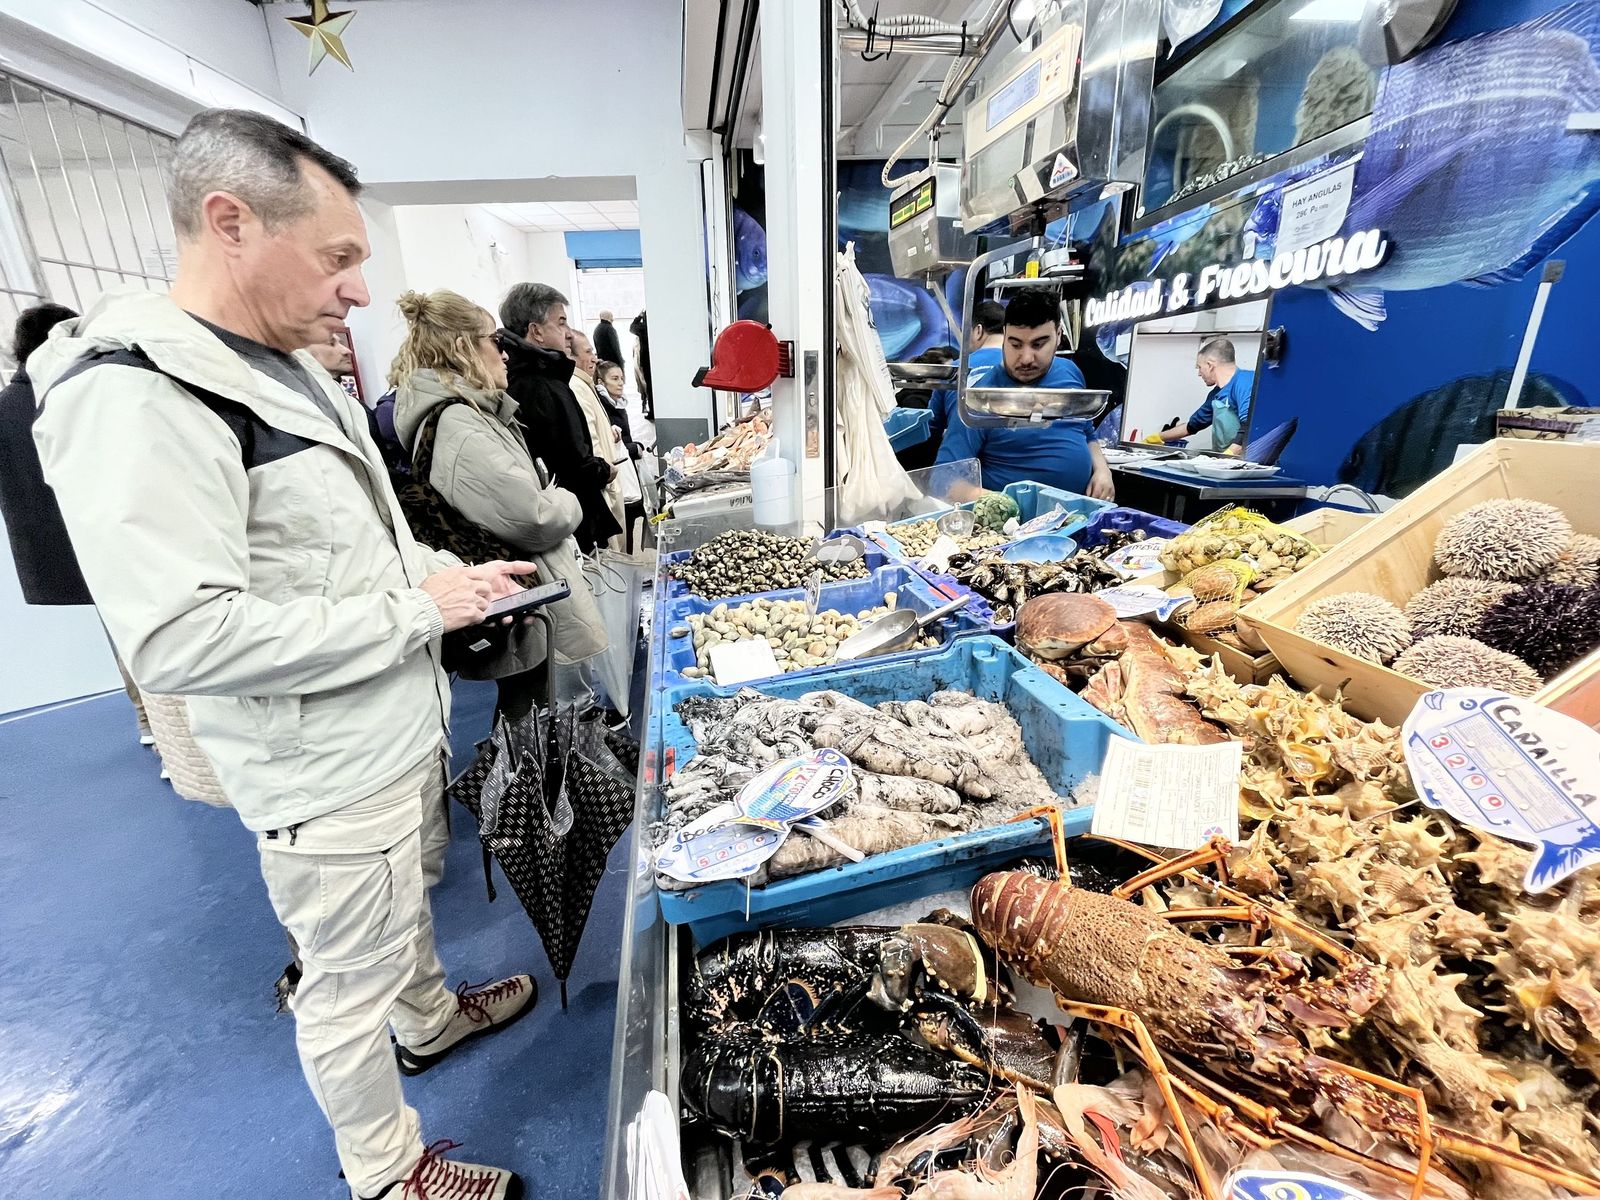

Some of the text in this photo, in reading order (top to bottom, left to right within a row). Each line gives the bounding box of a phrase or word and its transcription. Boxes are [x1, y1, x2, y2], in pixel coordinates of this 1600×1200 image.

[1292, 196, 1307, 208] HAY
[1308, 182, 1342, 202] ANGULAS
[1085, 278, 1164, 328] Calidad
[1168, 272, 1191, 312] &
[1197, 229, 1388, 304] Frescura
[812, 768, 844, 799] CHOCO
[1493, 704, 1597, 807] CAÑAILLA
